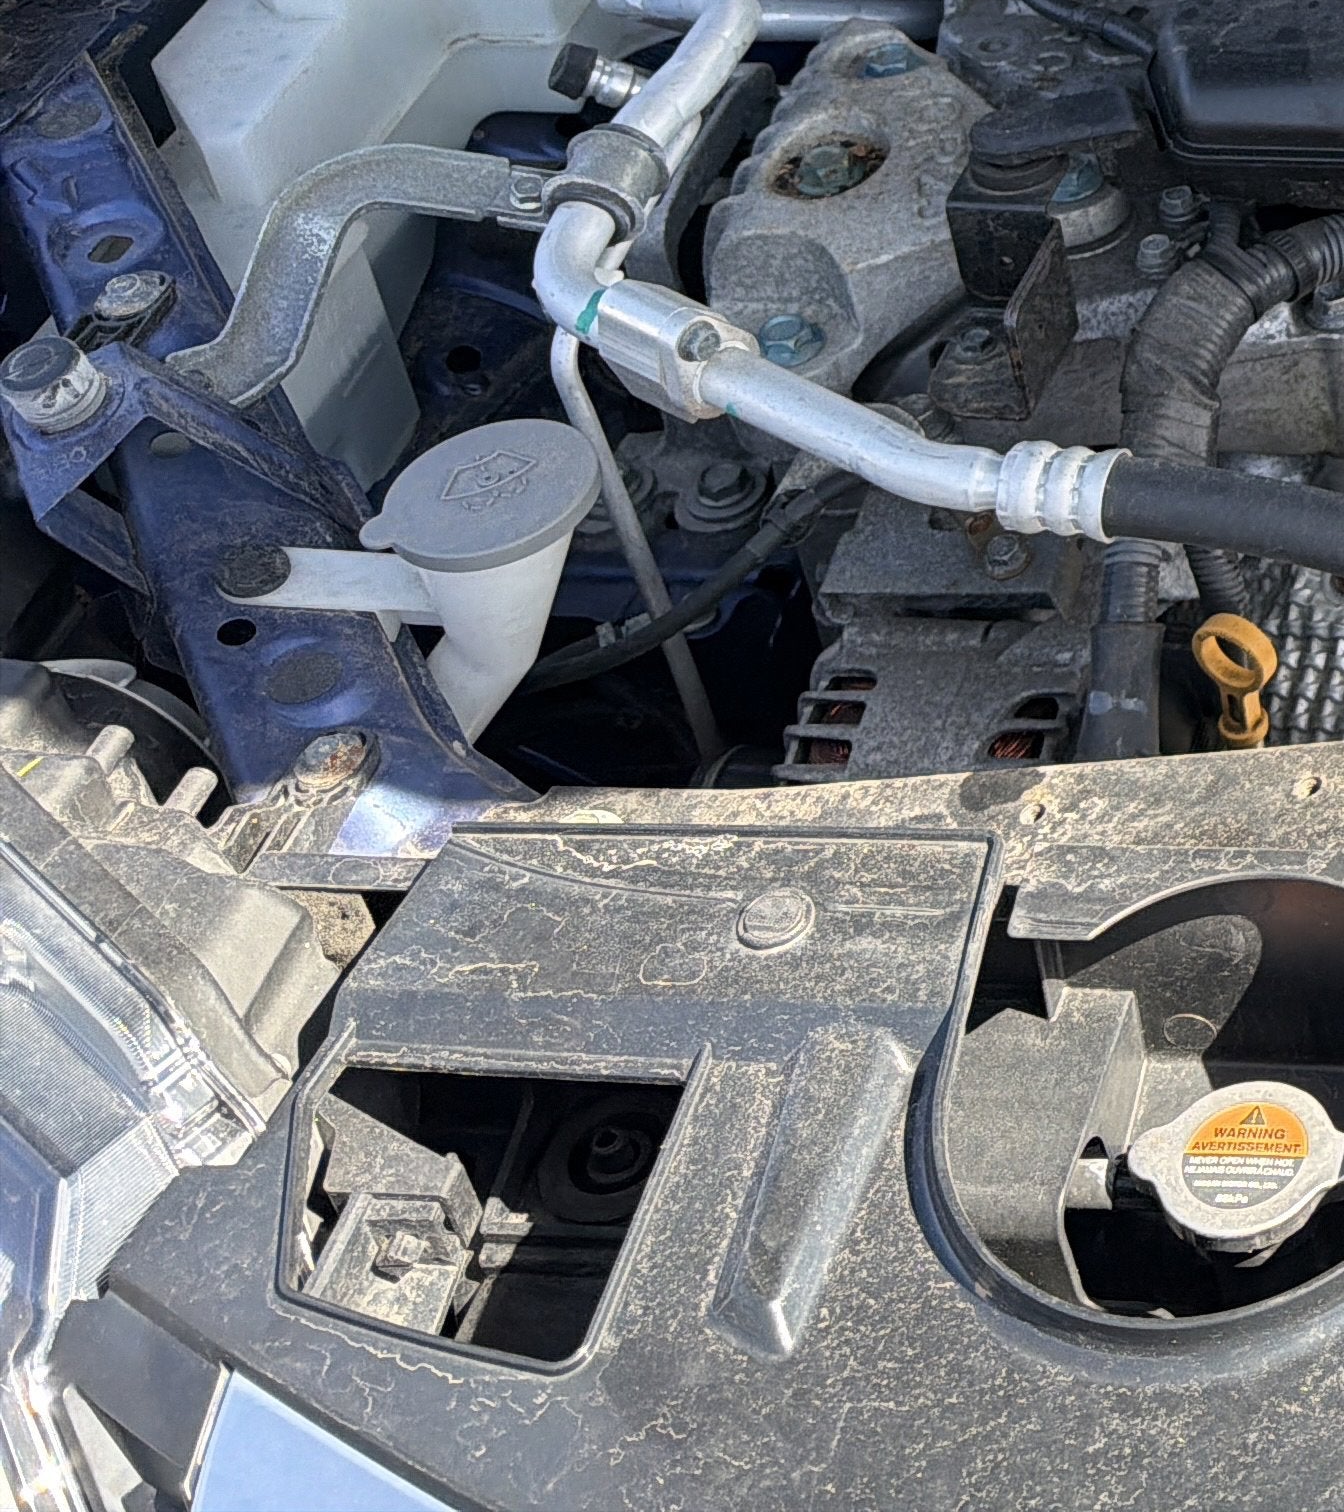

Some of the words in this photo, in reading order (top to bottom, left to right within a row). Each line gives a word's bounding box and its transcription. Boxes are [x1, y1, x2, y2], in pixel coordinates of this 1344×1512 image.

[1213, 1127, 1286, 1140] WARNING
[1191, 1141, 1302, 1154] AVERTISSEMENT
[1189, 1156, 1219, 1165] NEVER
[1220, 1156, 1244, 1165] OPEN
[1245, 1157, 1273, 1167] WHEN
